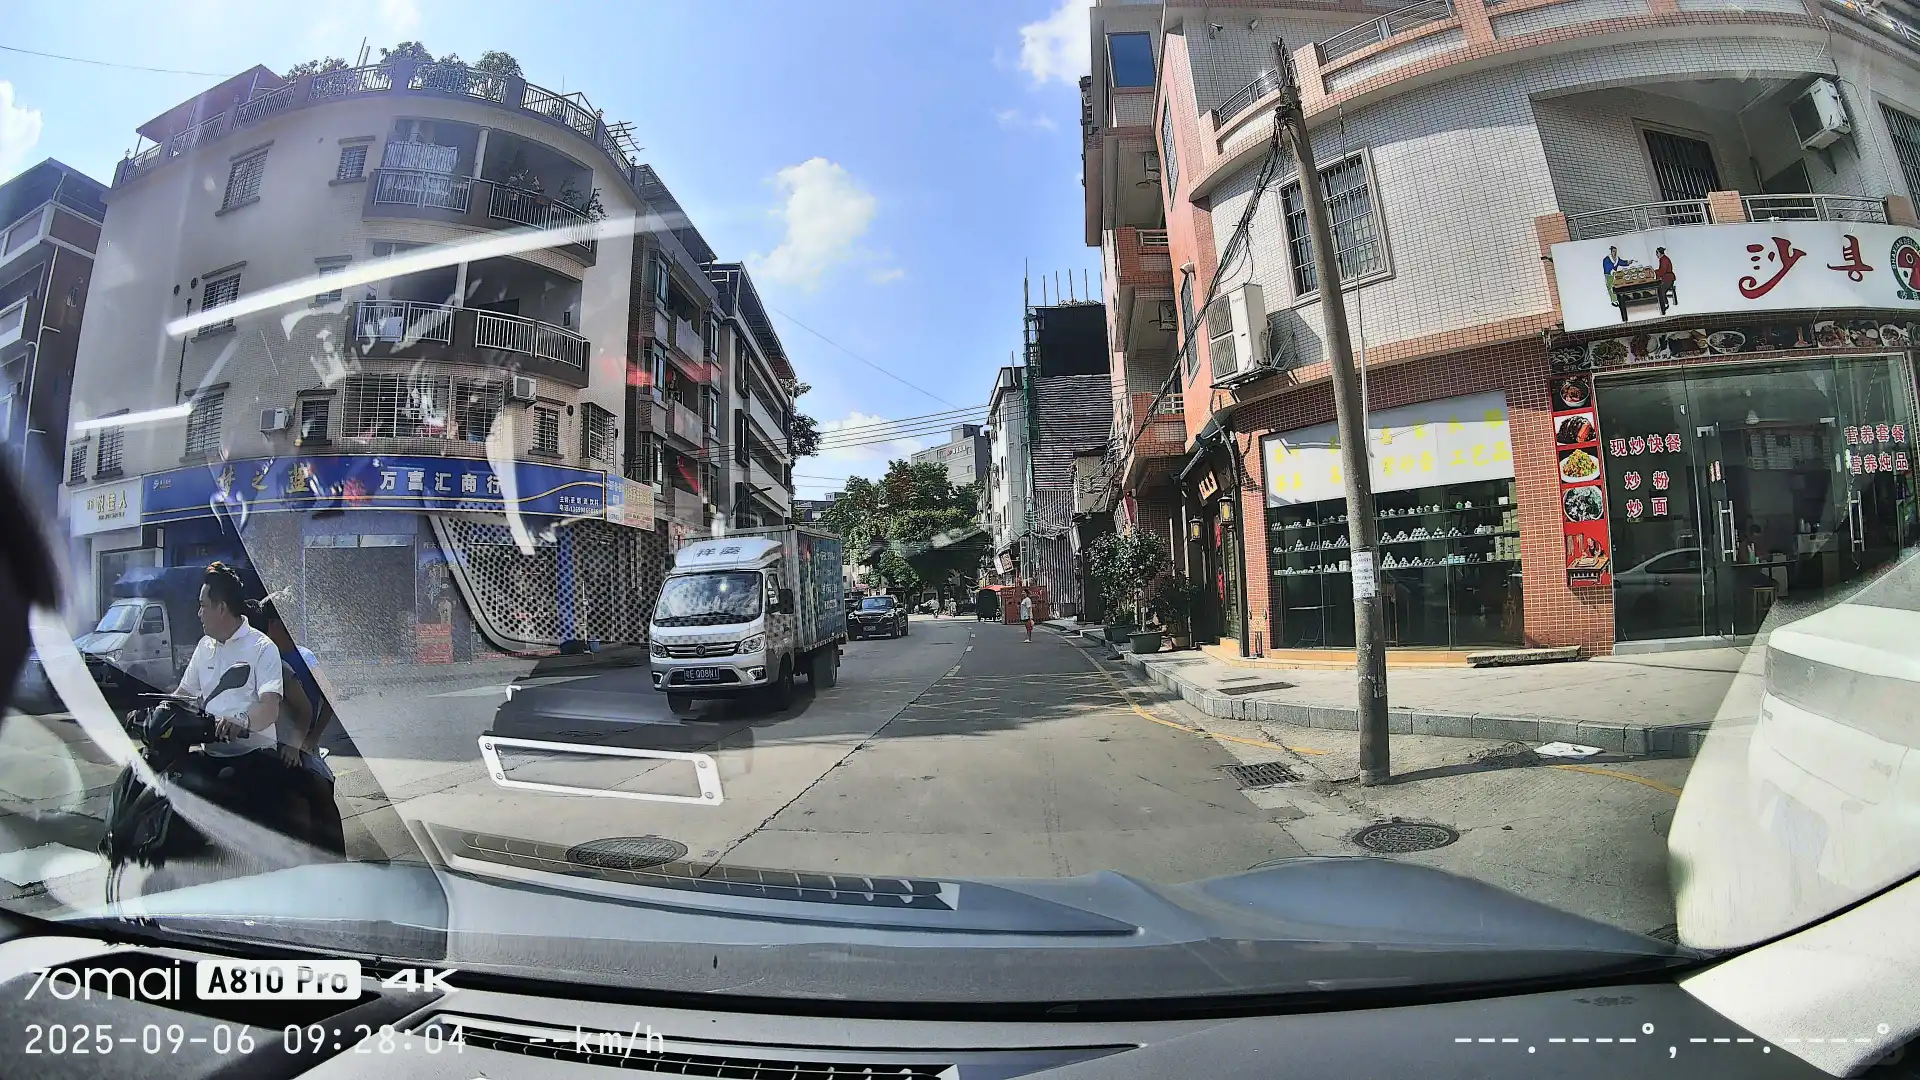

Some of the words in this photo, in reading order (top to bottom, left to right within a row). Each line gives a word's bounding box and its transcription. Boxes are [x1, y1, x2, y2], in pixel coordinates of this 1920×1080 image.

[1844, 423, 1905, 444] 营养套餐
[1610, 434, 1682, 457] 现炒快餐
[1850, 452, 1909, 475] 营养炖品
[1624, 471, 1669, 490] 炒粉
[1626, 497, 1668, 518] 炒面
